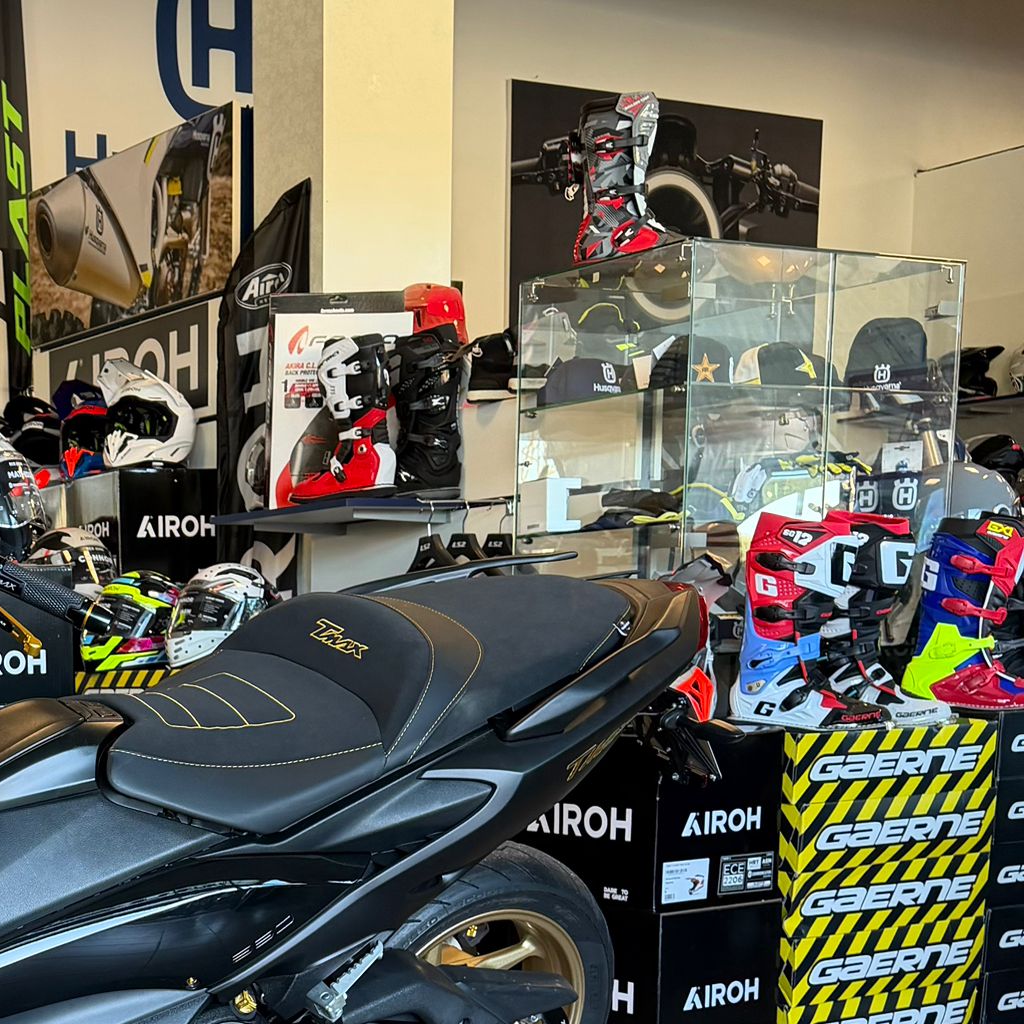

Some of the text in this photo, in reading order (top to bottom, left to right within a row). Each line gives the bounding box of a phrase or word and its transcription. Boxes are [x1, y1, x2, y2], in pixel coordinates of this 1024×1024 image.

[79, 521, 110, 537] IROH
[136, 515, 216, 538] AIROH
[451, 541, 467, 549] LS2
[681, 806, 762, 837] AIROH
[723, 863, 745, 874] ECE
[724, 875, 743, 884] 2206
[683, 977, 760, 1011] AIROH
